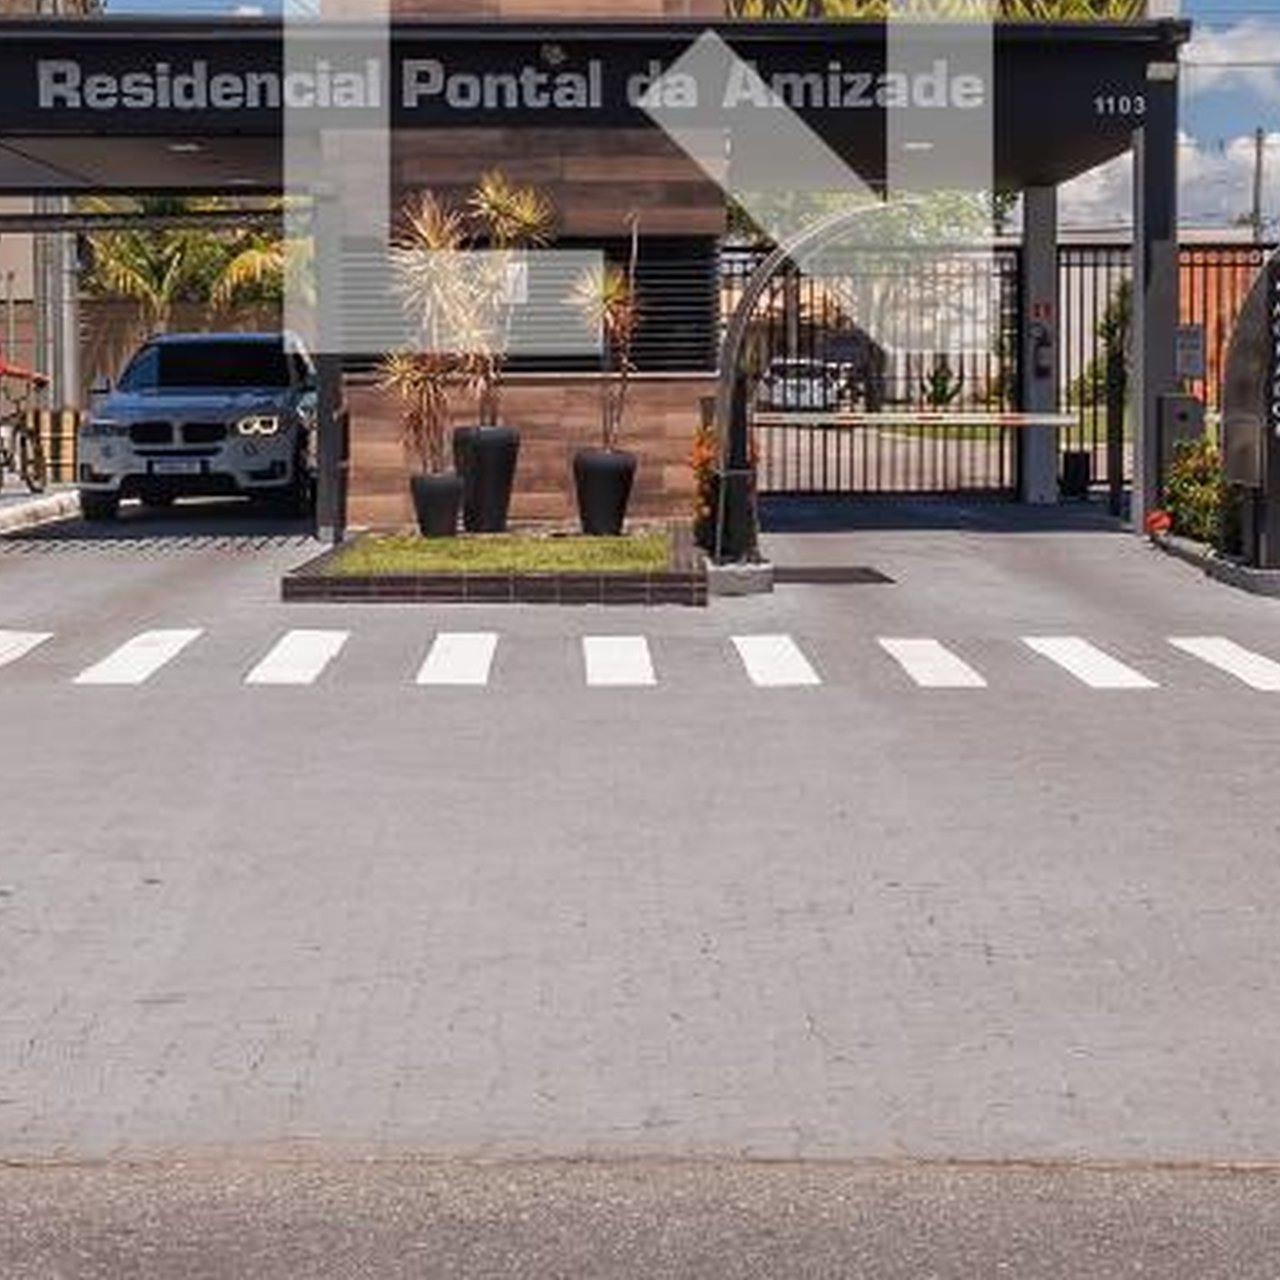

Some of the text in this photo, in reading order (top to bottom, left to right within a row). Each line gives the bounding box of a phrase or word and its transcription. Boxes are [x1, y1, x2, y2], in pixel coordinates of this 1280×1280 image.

[36, 58, 986, 109] Residencial Pontal da Amizade
[1093, 95, 1147, 115] 1103
